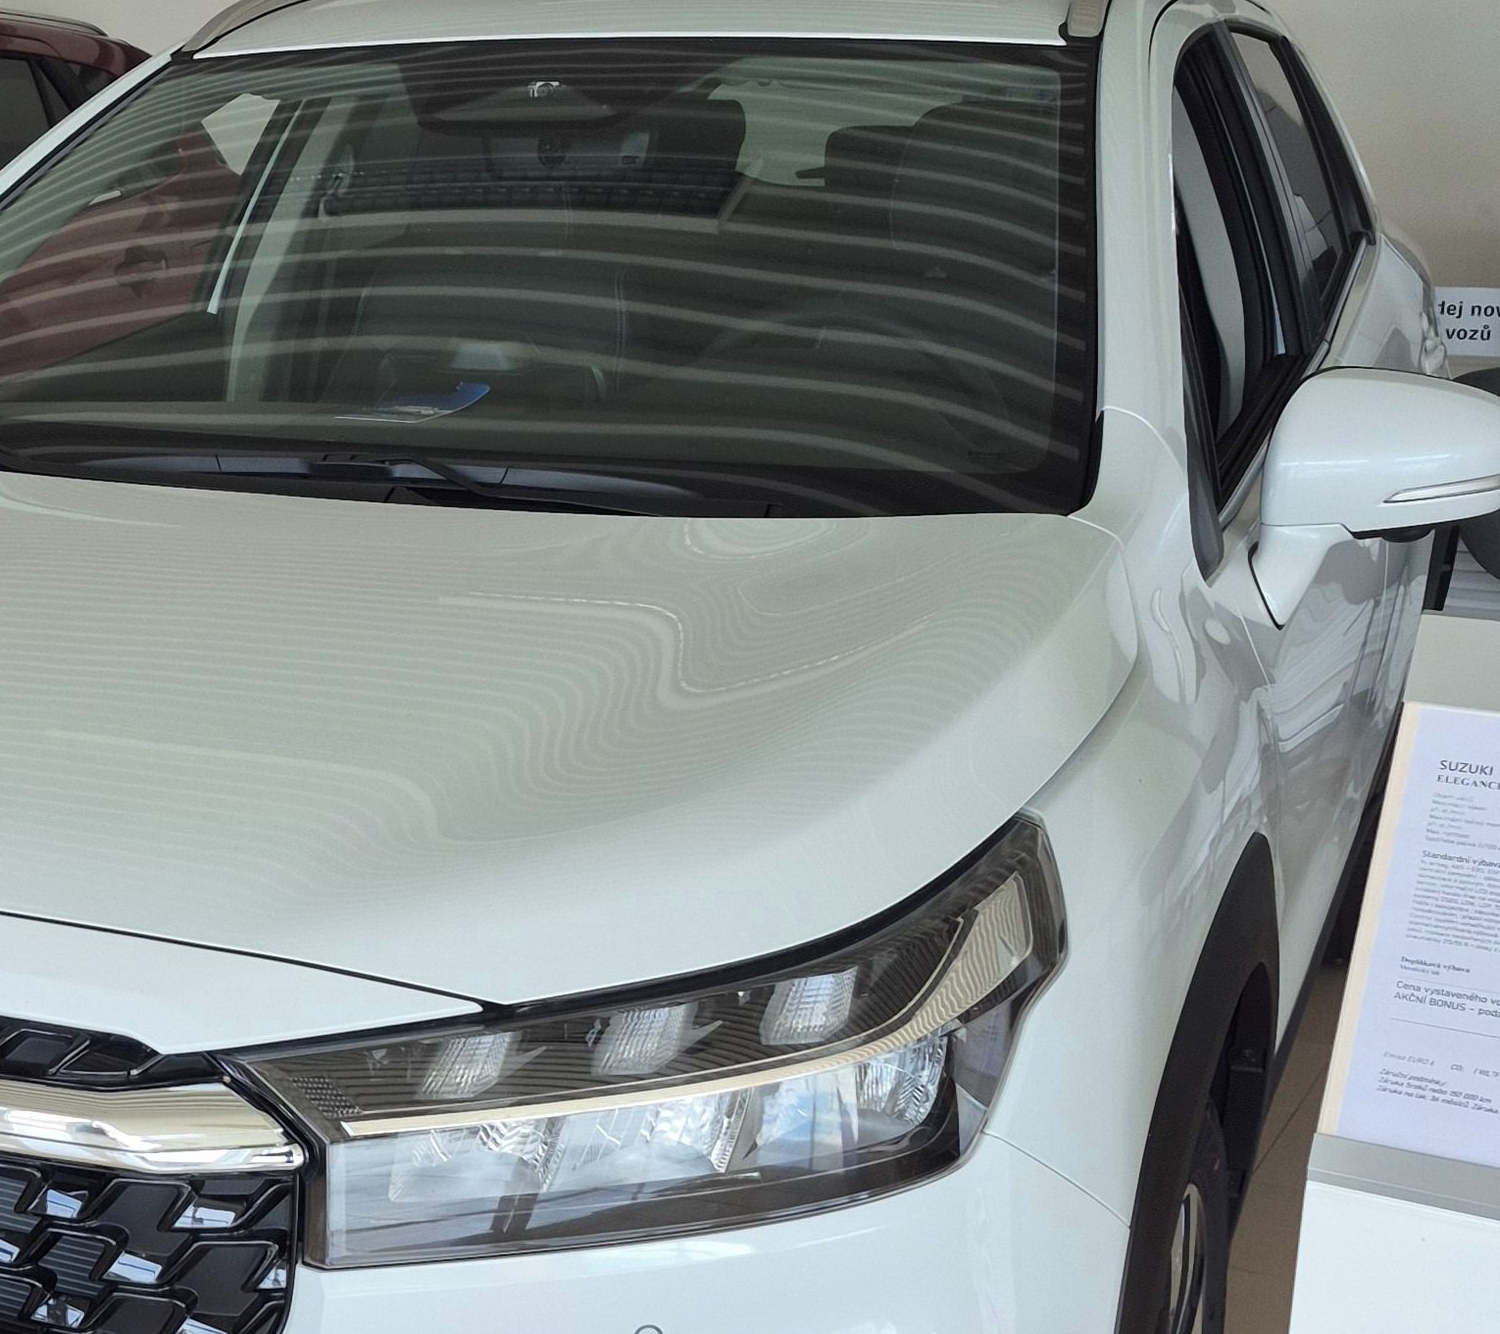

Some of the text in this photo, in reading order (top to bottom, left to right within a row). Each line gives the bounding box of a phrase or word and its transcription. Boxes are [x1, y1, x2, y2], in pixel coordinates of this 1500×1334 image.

[1445, 324, 1491, 341] vozů
[1439, 760, 1494, 776] SUZUKI
[1396, 980, 1421, 992] Cena
[1424, 987, 1488, 1003] vystaveného
[1394, 991, 1427, 1004] AKČNÍ
[1429, 997, 1466, 1012] BONUS
